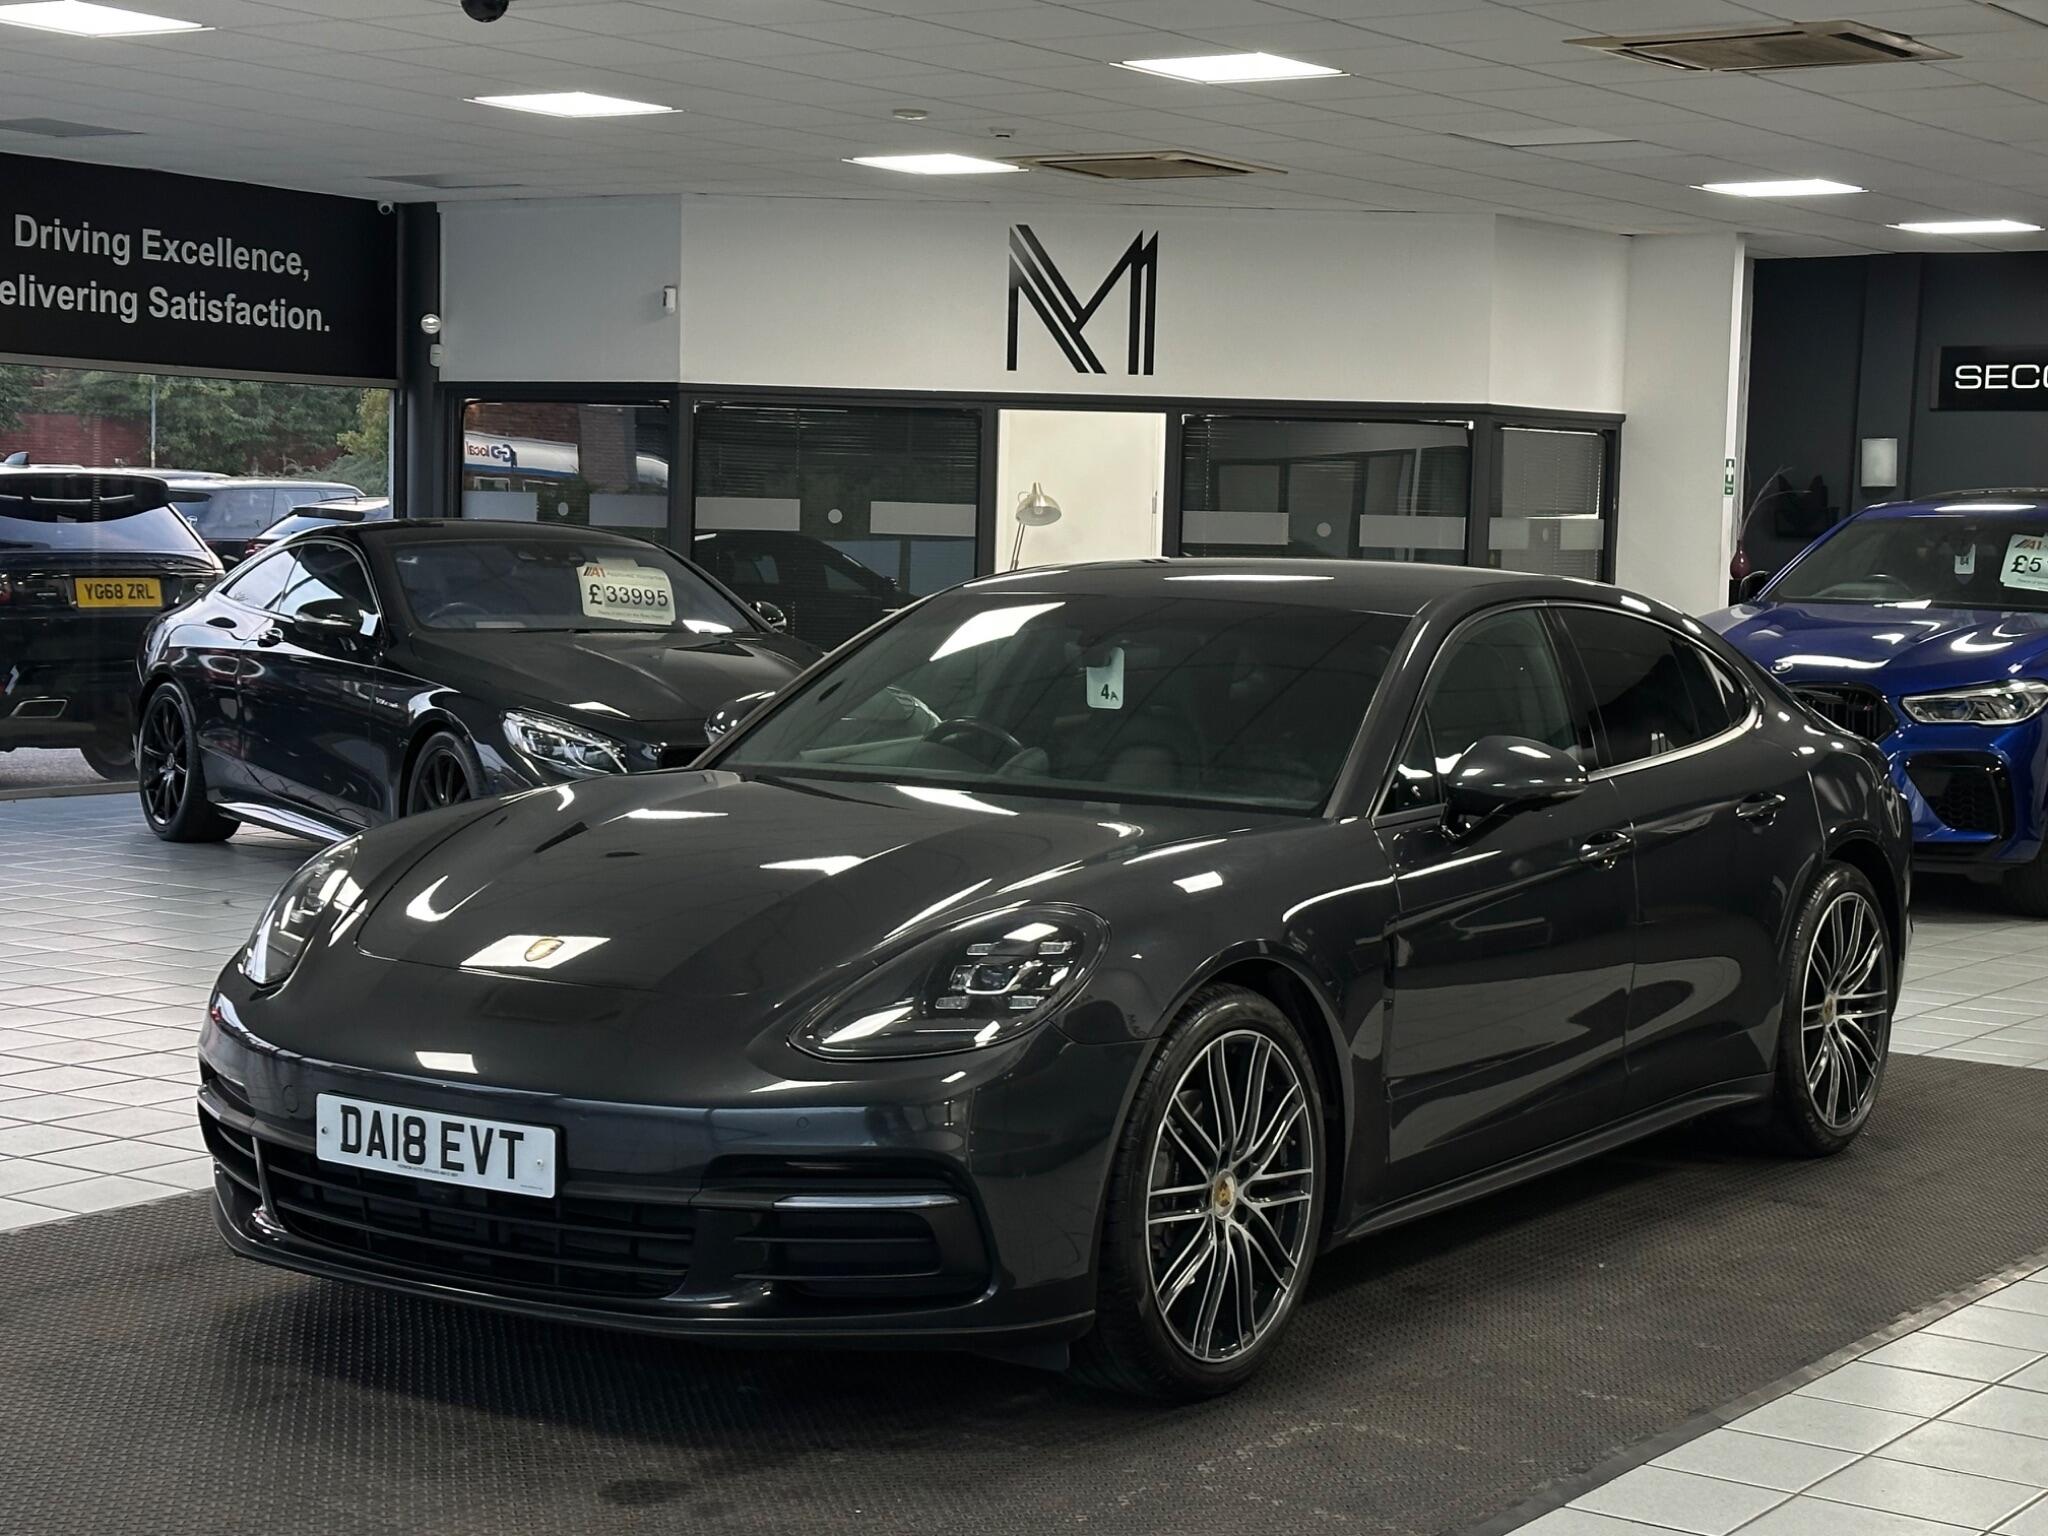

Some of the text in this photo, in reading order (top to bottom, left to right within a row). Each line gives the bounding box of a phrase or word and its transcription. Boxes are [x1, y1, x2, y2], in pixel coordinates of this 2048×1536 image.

[15, 214, 310, 282] Driving Excellence,
[149, 286, 331, 332] Satisfaction.
[1955, 364, 2048, 389] SEC
[2011, 555, 2048, 574] £5
[84, 584, 155, 600] YG68 ZRL
[588, 584, 668, 607] £33995
[340, 1104, 524, 1180] DA18 EVT
